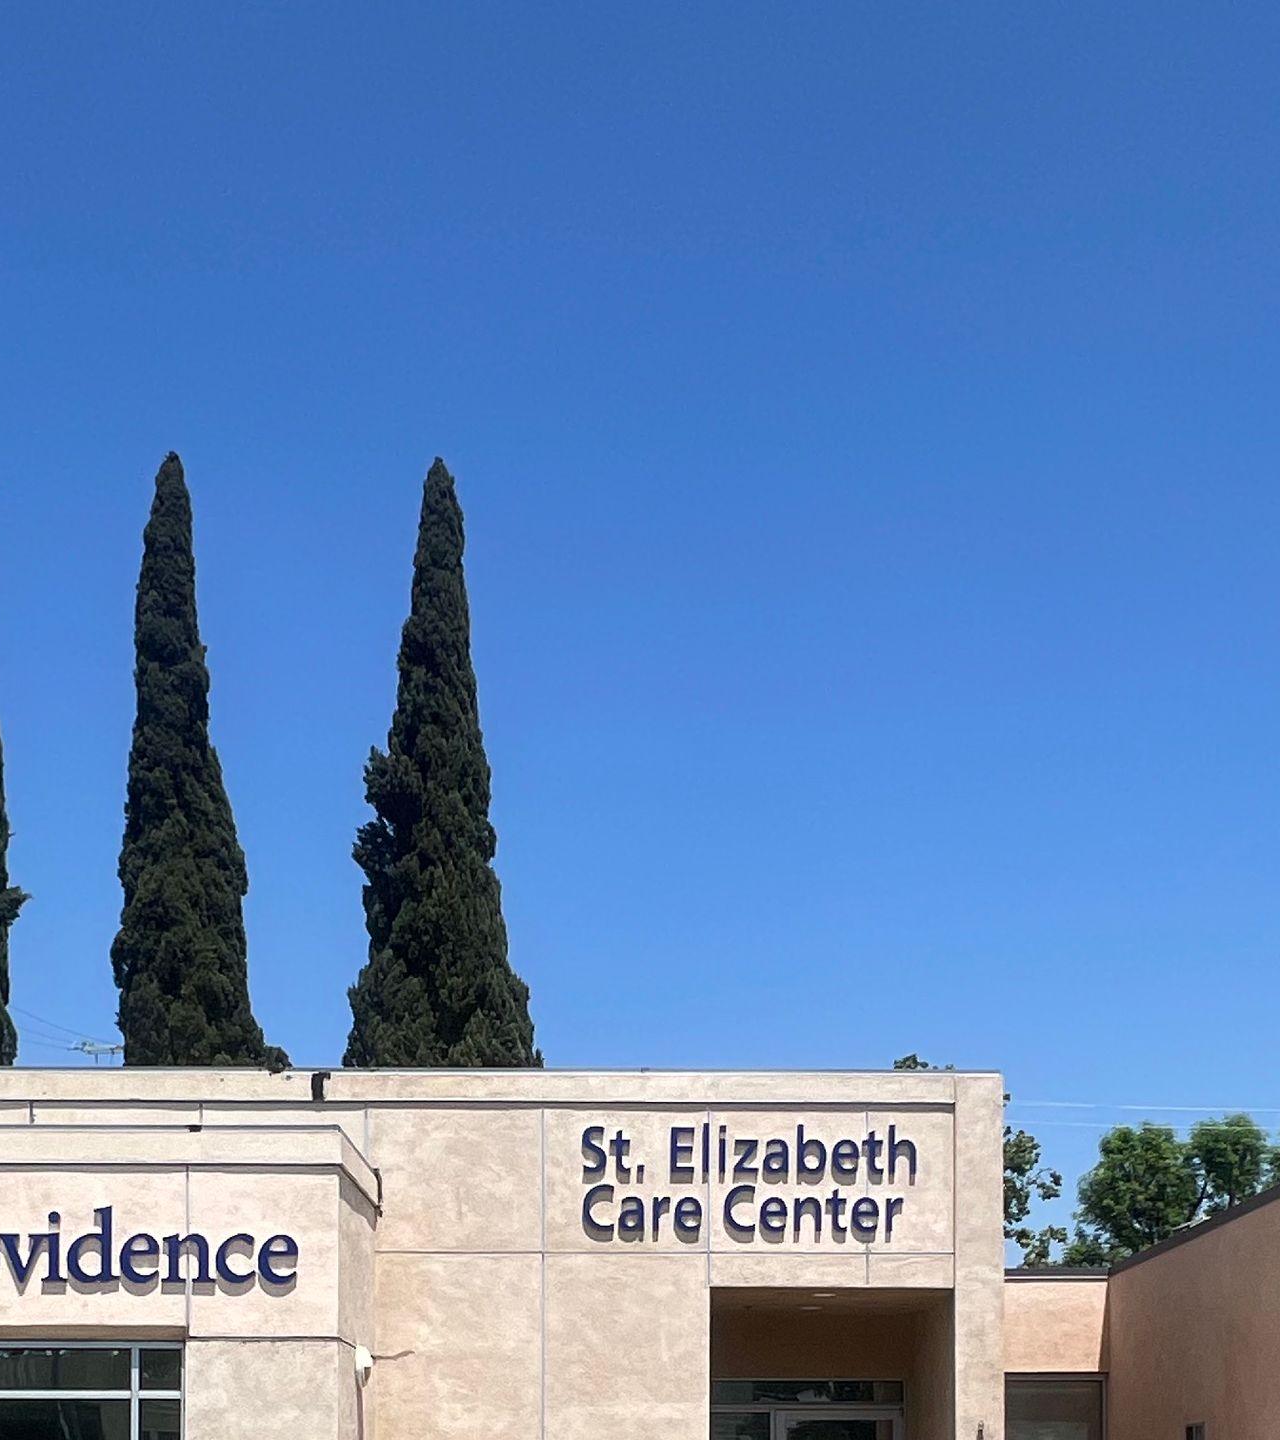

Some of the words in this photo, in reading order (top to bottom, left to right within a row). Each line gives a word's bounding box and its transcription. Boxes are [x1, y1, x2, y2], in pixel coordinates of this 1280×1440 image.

[582, 1126, 645, 1180] St.
[670, 1123, 917, 1180] Elizabeth
[582, 1184, 703, 1237] Care
[724, 1185, 904, 1237] Center
